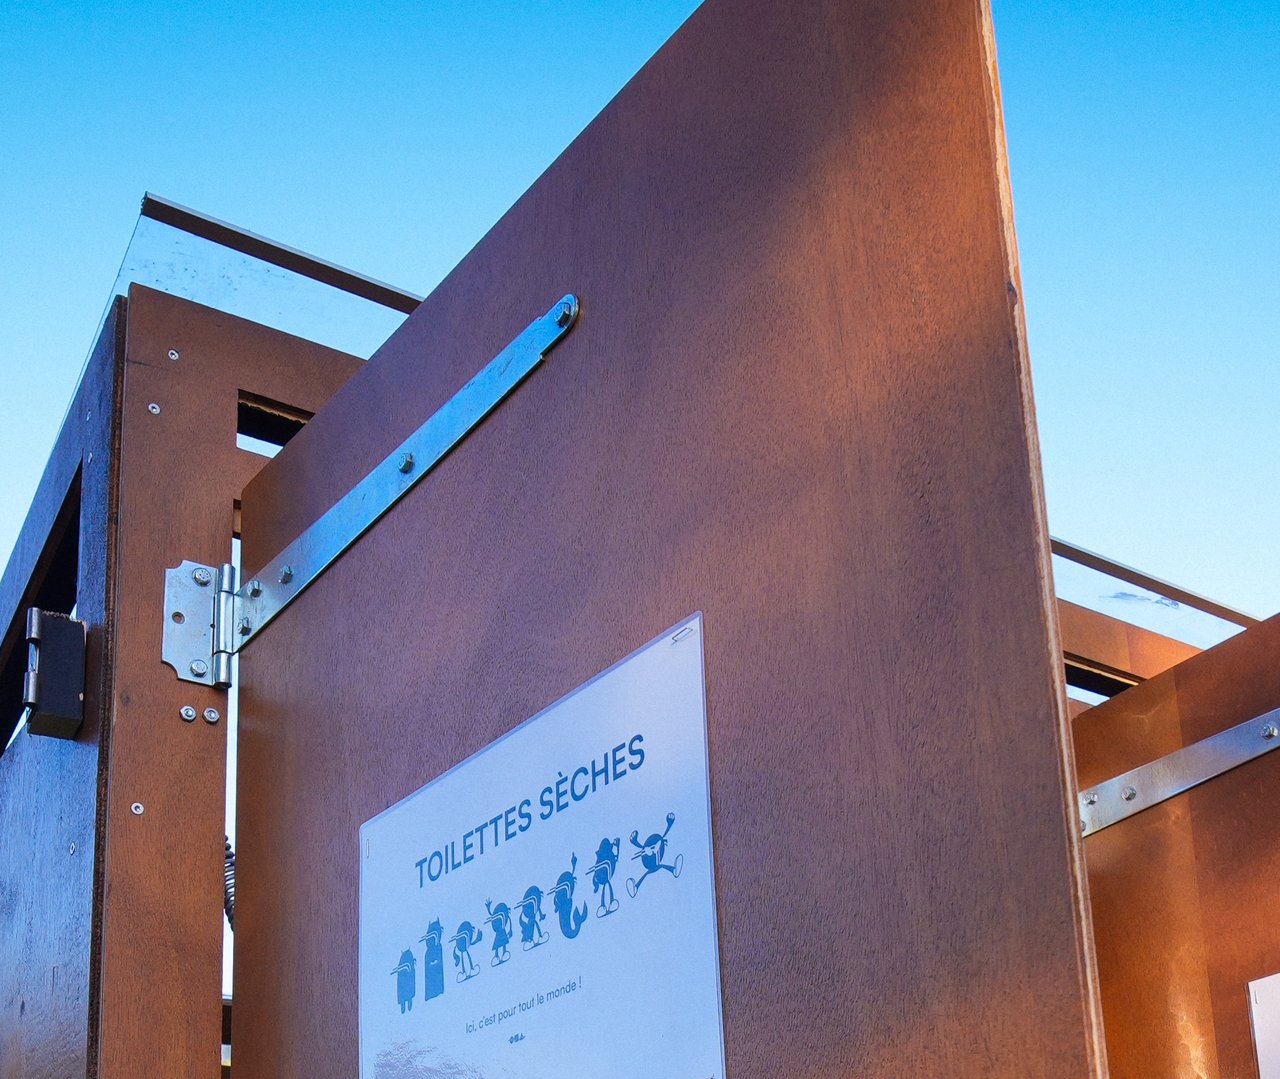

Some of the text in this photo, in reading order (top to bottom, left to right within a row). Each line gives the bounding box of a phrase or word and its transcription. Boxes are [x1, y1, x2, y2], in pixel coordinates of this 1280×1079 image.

[415, 734, 645, 889] TOILETTES SÈCHES
[465, 1020, 477, 1034] Ici,
[478, 1012, 496, 1029] c'est
[497, 1006, 517, 1024] pour
[518, 997, 535, 1013] tout
[537, 993, 545, 1005] le
[546, 980, 577, 1002] monde
